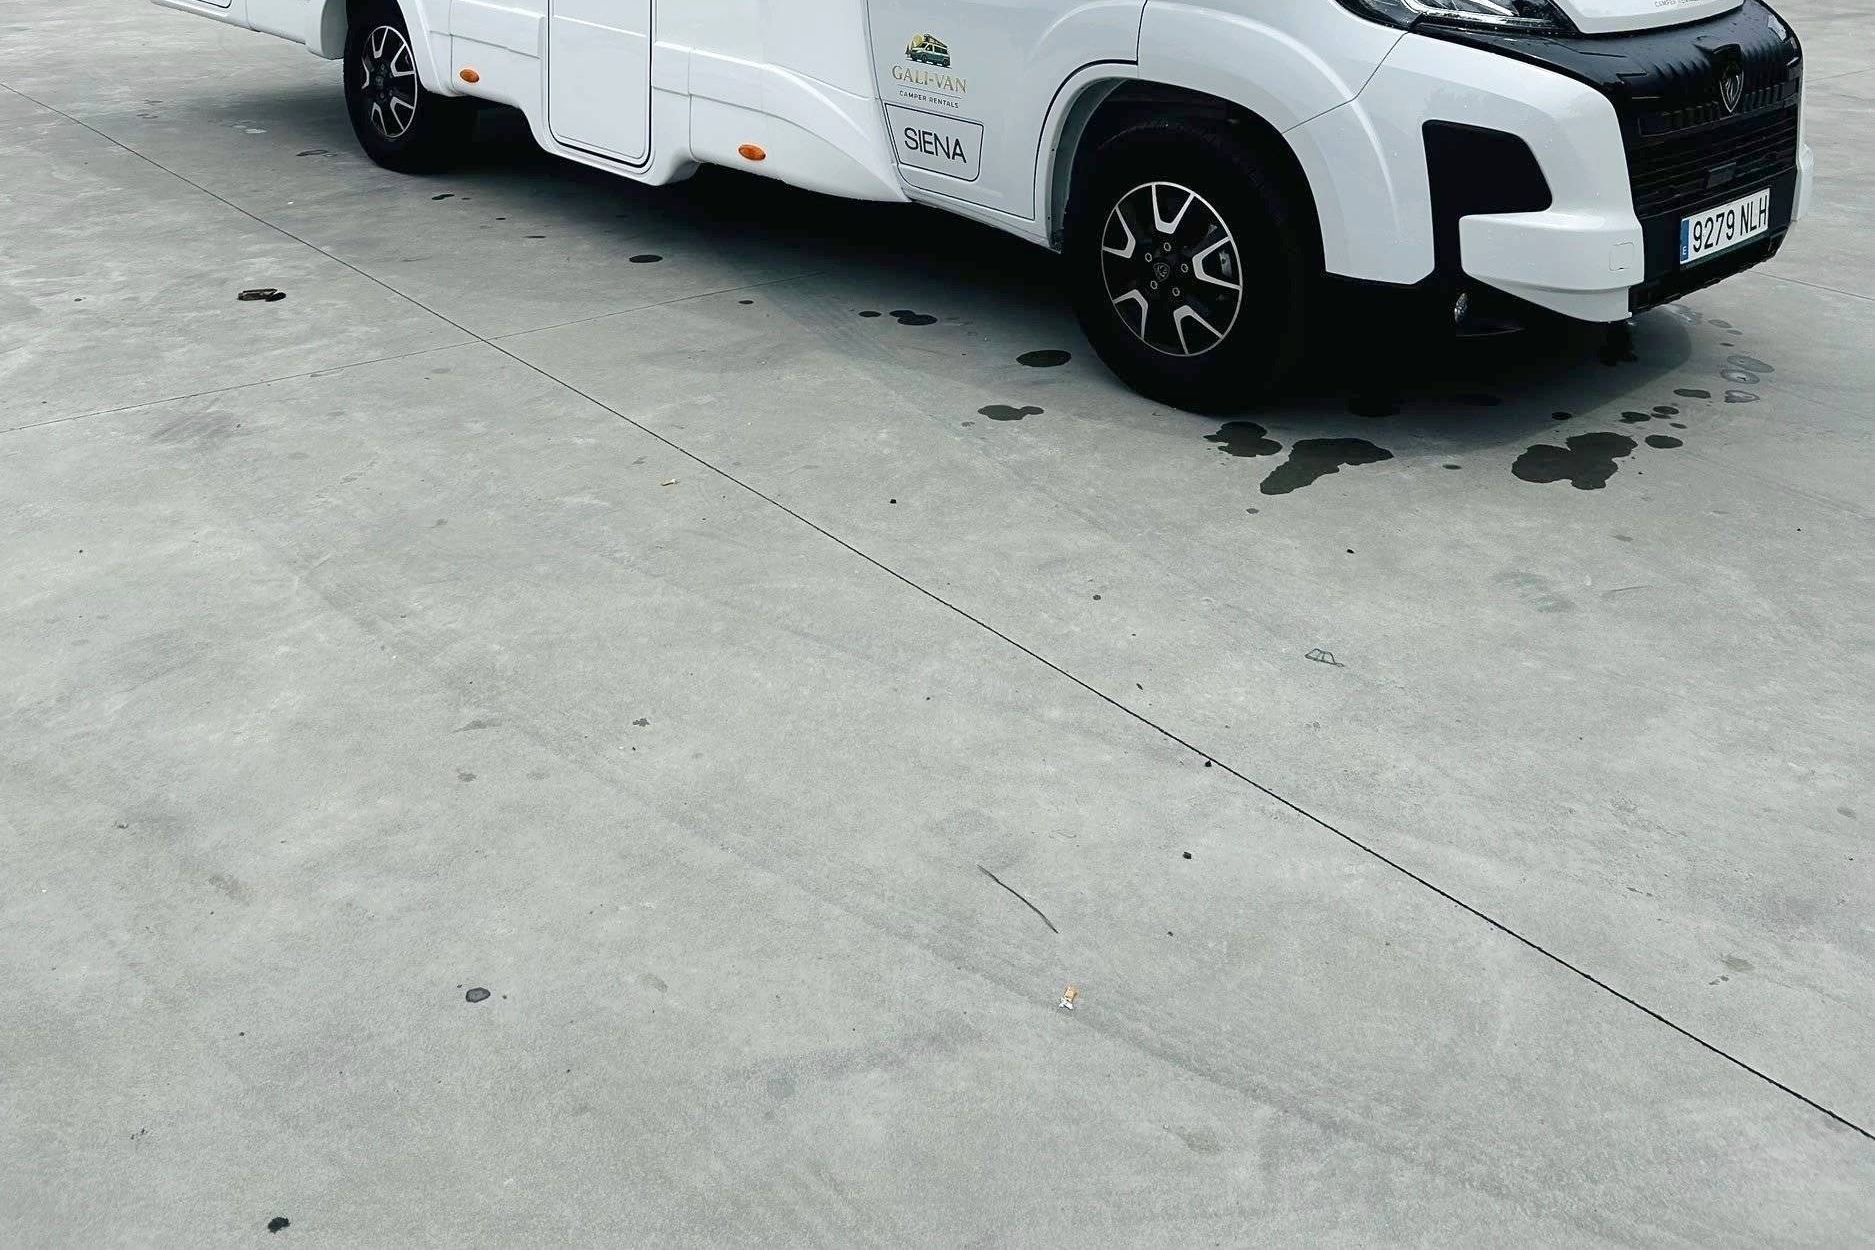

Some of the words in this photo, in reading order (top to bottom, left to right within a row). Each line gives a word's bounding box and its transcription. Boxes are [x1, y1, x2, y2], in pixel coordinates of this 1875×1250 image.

[891, 65, 967, 94] GALI-VAN
[899, 90, 928, 102] CAMPER
[928, 97, 959, 109] RENTALS
[904, 126, 967, 164] SIENA
[1692, 209, 1736, 253] 9279
[1740, 194, 1768, 237] NLH
